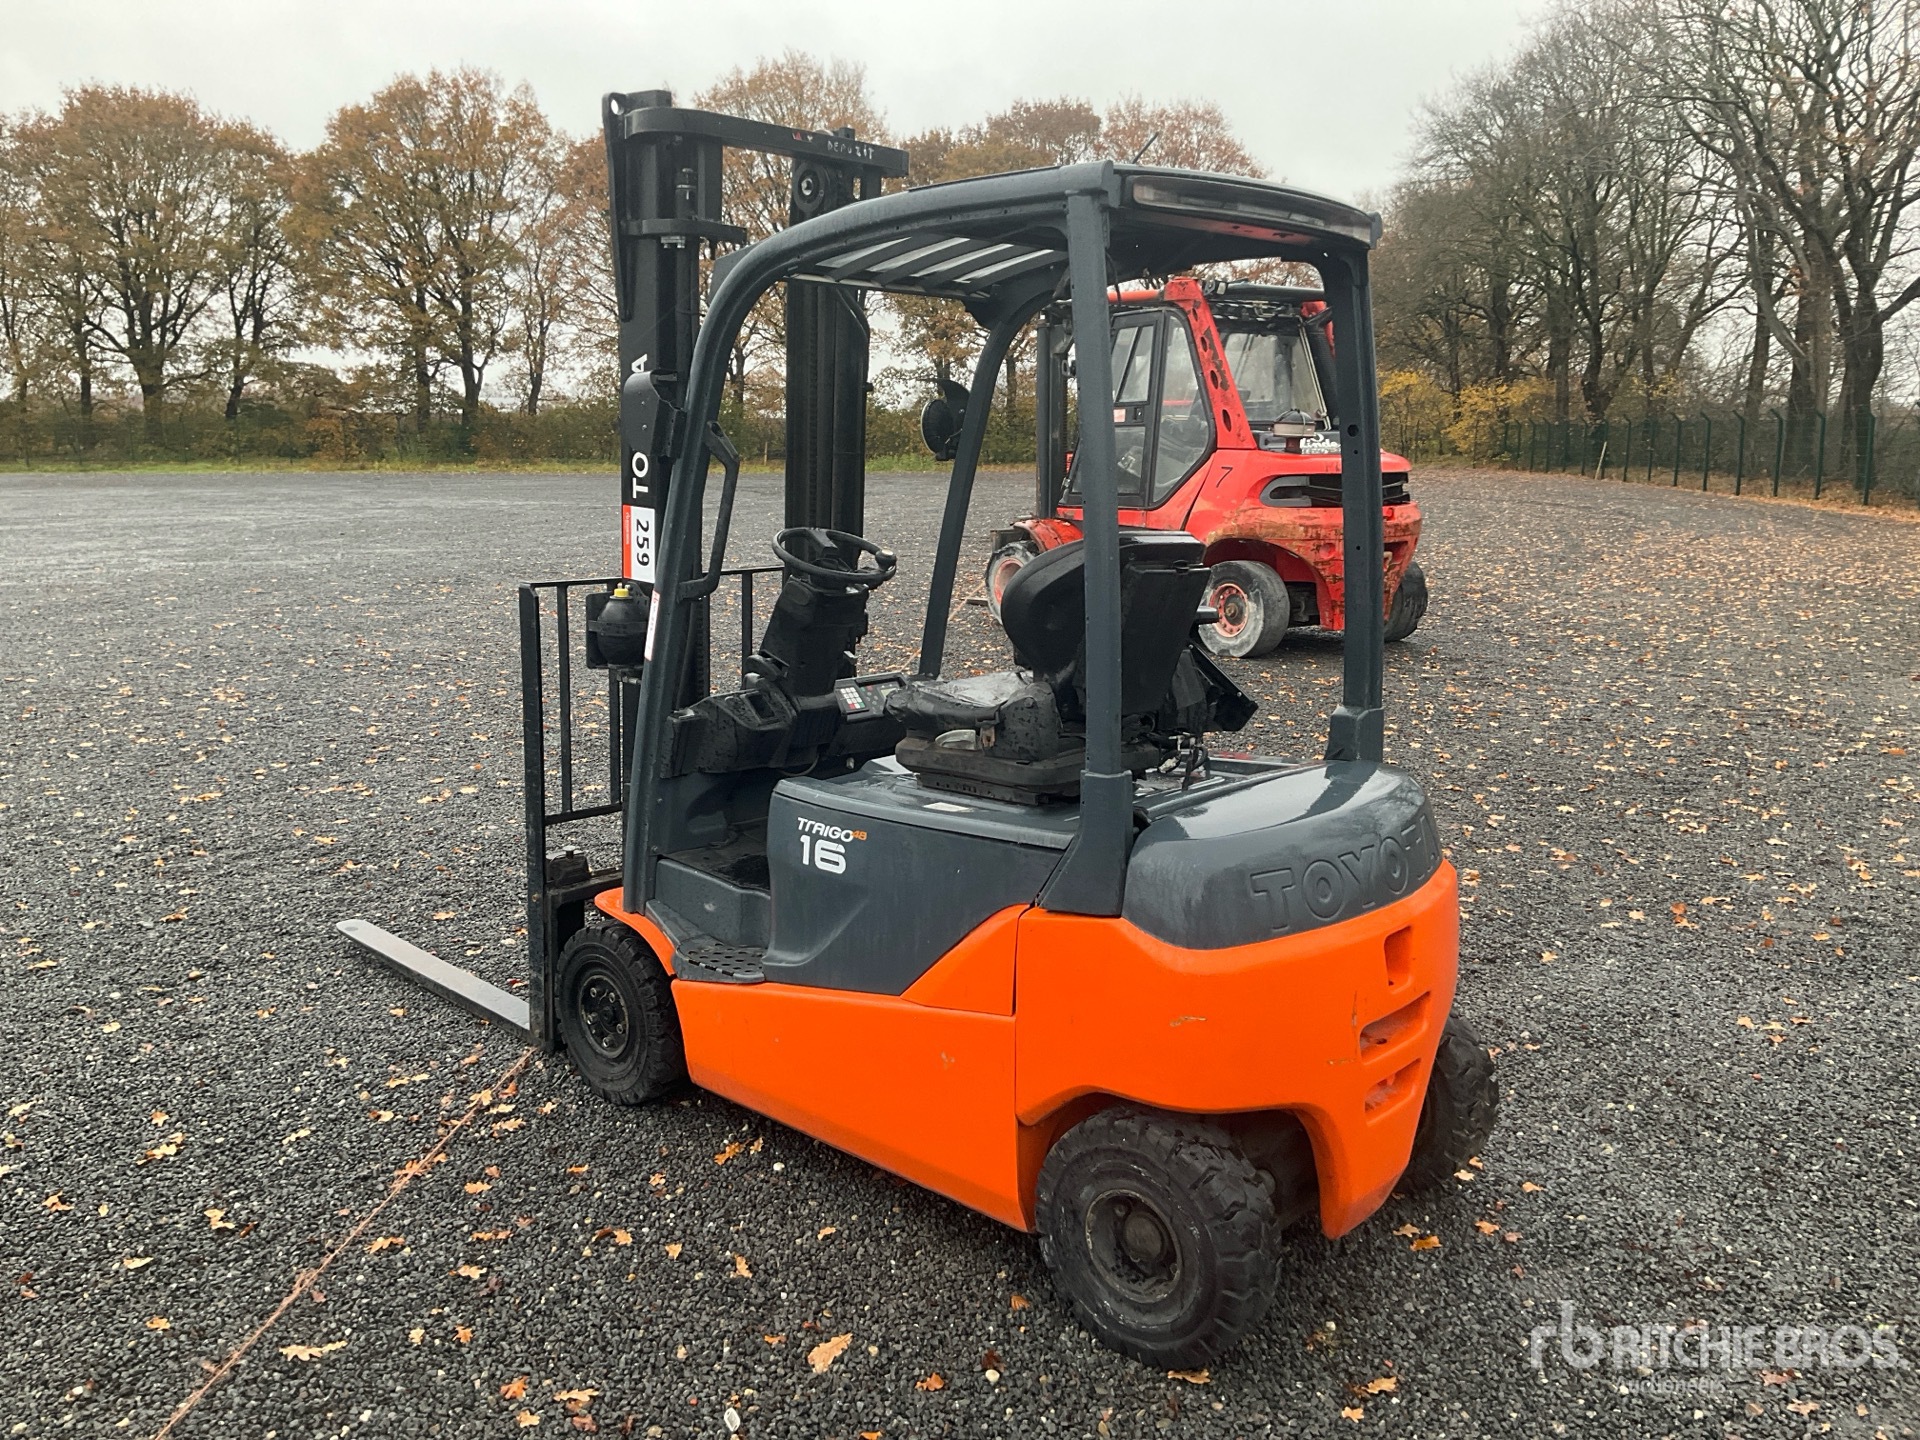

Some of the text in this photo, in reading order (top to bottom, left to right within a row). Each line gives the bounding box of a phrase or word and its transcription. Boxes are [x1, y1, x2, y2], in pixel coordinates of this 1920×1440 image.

[1216, 466, 1233, 488] 7
[636, 518, 650, 567] 259
[800, 834, 846, 874] 16
